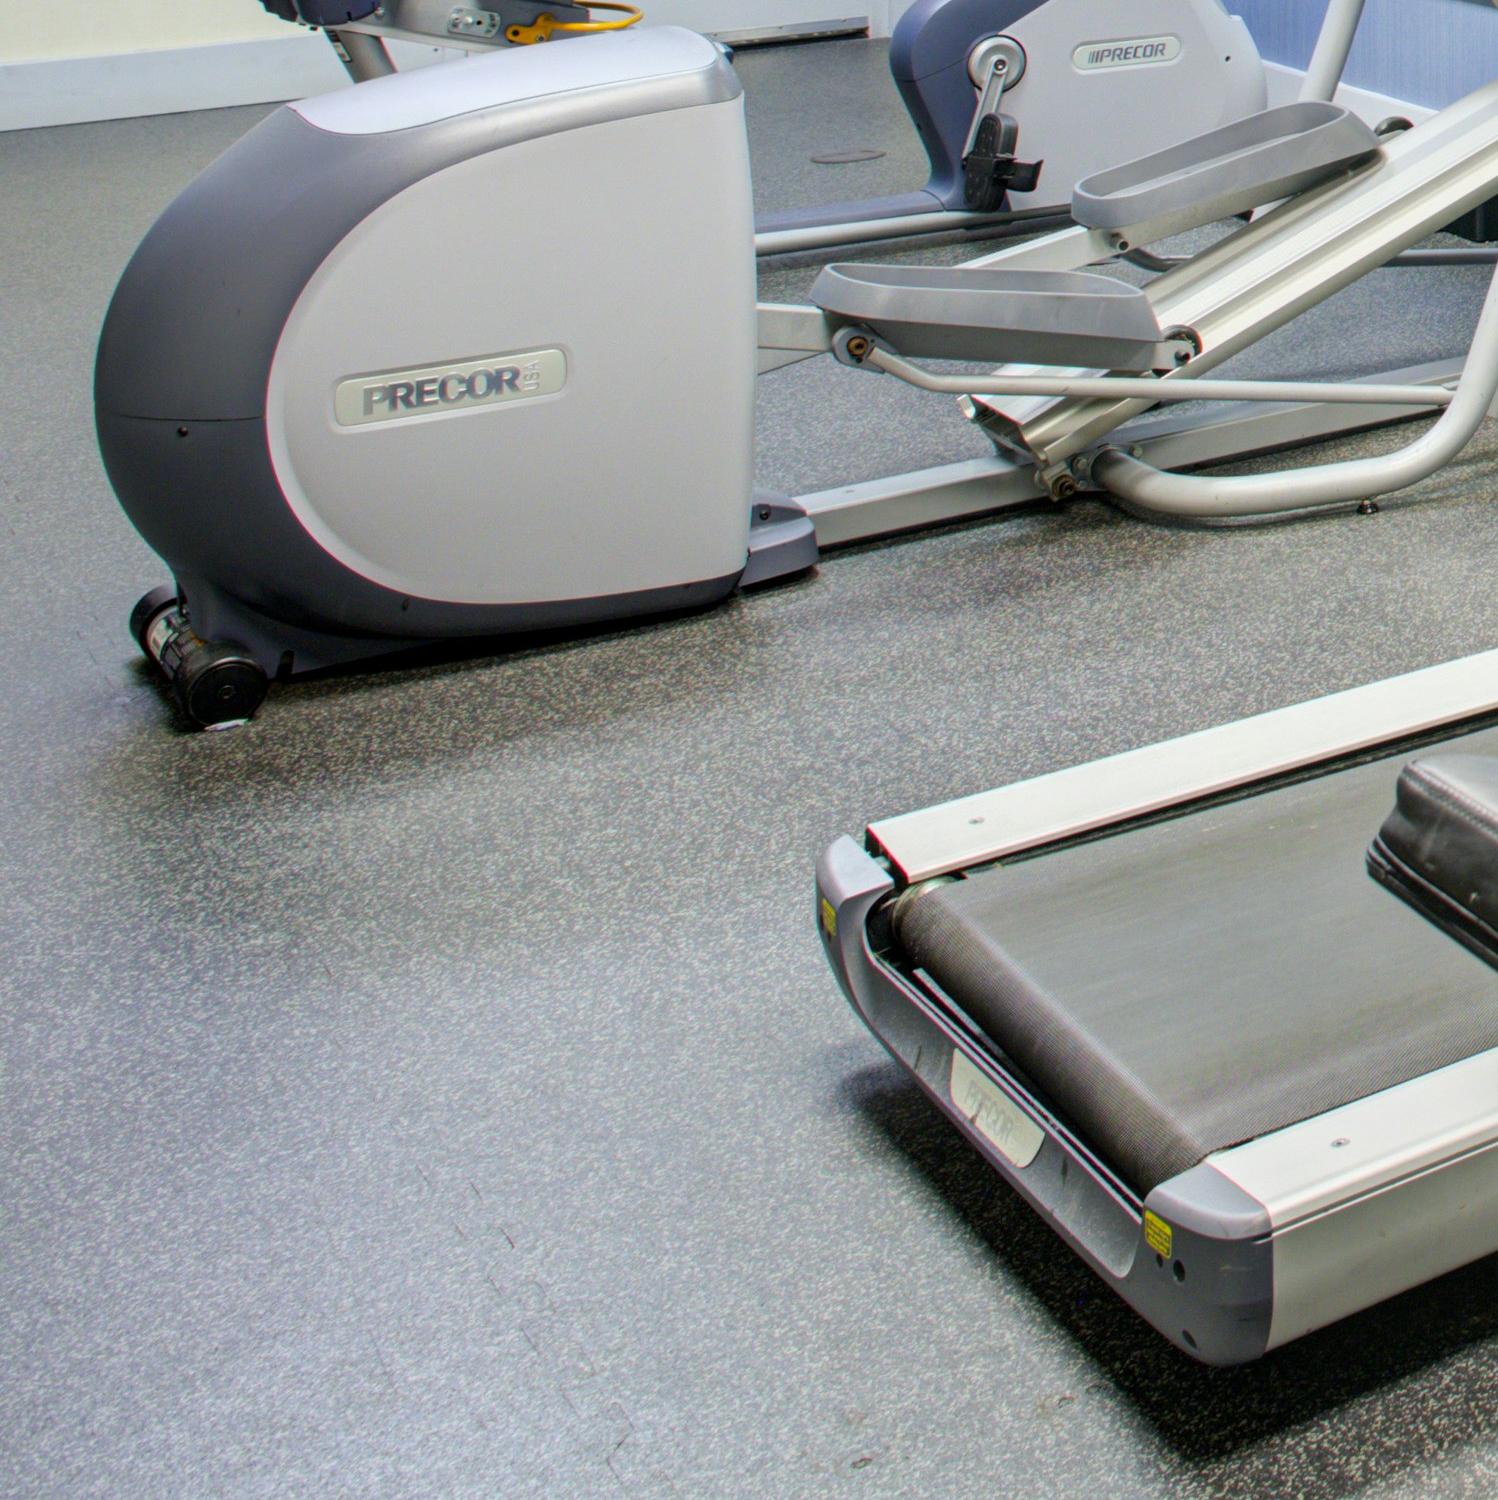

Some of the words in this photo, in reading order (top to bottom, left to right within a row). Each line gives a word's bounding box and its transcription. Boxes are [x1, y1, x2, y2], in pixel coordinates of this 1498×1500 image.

[1100, 43, 1166, 63] PRECOR
[362, 364, 522, 417] PRECOR
[523, 359, 541, 392] USA
